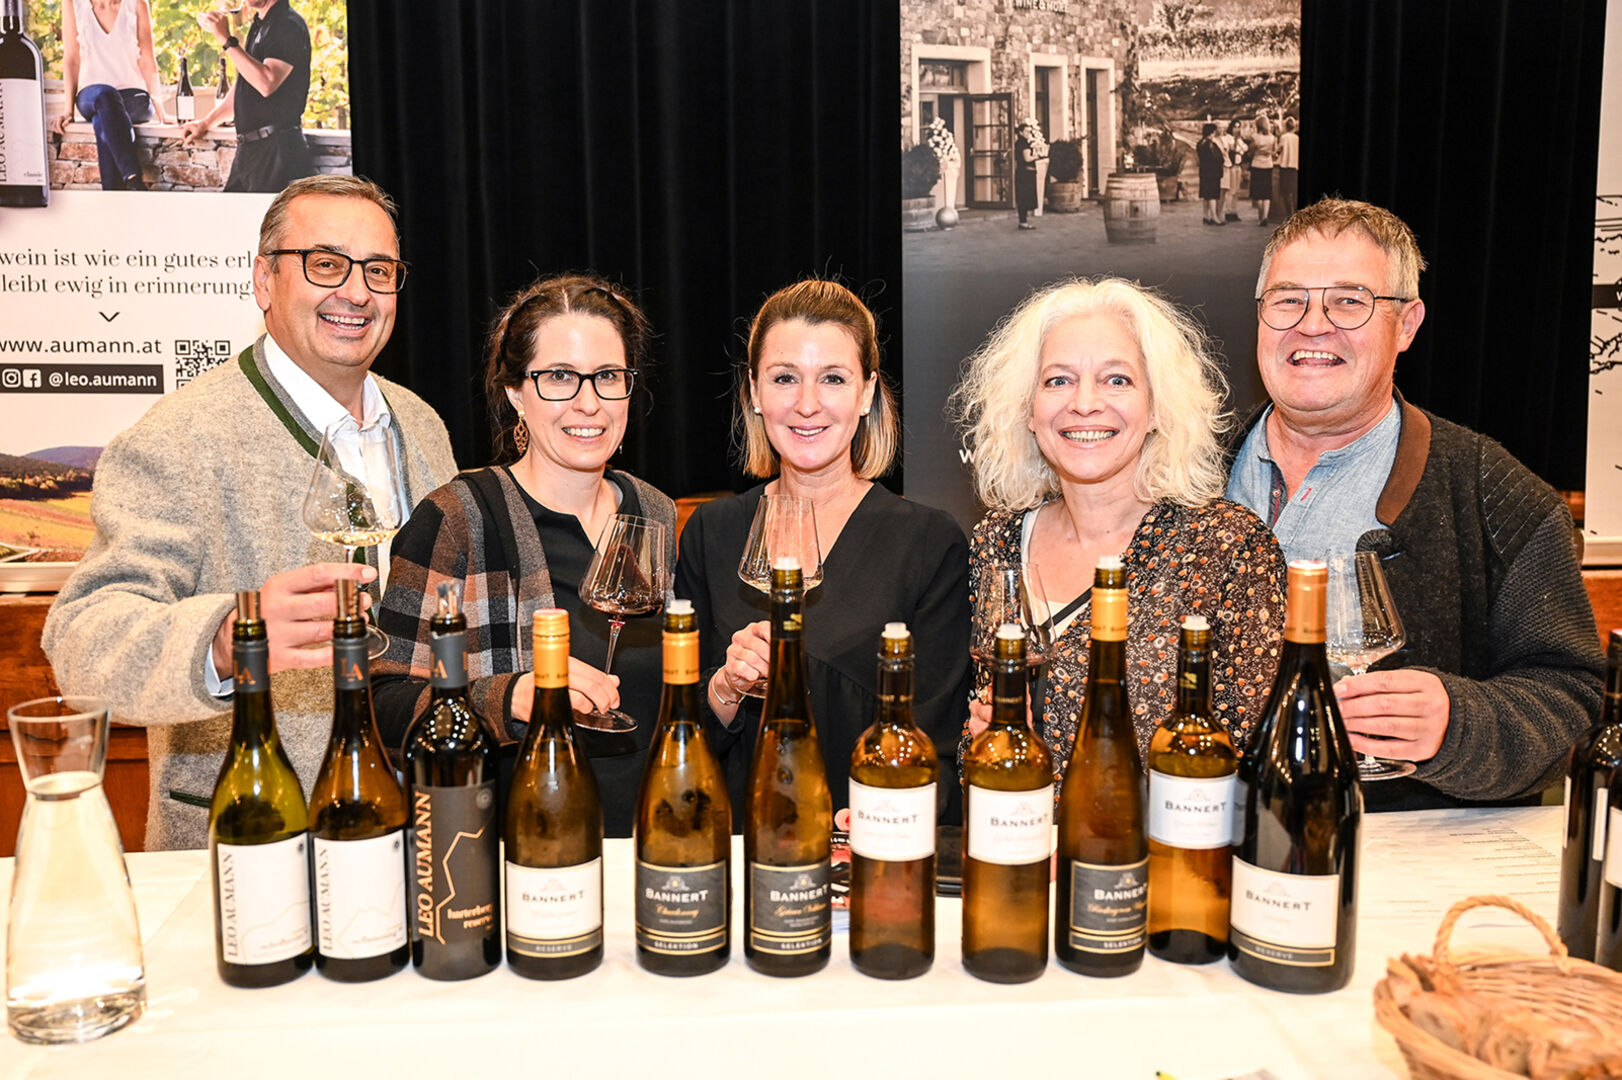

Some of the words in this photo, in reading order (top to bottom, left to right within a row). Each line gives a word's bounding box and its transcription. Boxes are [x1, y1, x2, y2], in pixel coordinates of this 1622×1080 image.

[0, 248, 47, 266] wein
[54, 249, 78, 266] ist
[84, 249, 120, 267] wie
[126, 250, 158, 267] ein
[164, 252, 219, 273] gutes
[225, 250, 252, 268] erl
[1, 274, 48, 293] leibt
[54, 276, 103, 298] ewig
[109, 277, 127, 293] in
[49, 371, 157, 388] @leo.aumann
[1164, 799, 1227, 813] BANNERT
[857, 809, 918, 824] BANNERT
[990, 812, 1048, 828] BANNERT
[414, 789, 433, 892] AUMANN
[522, 889, 584, 903] BANNERT
[645, 887, 709, 903] BANNERT
[769, 883, 829, 903] BANNERT
[1245, 888, 1313, 911] BANNERT
[417, 892, 434, 937] LEO
